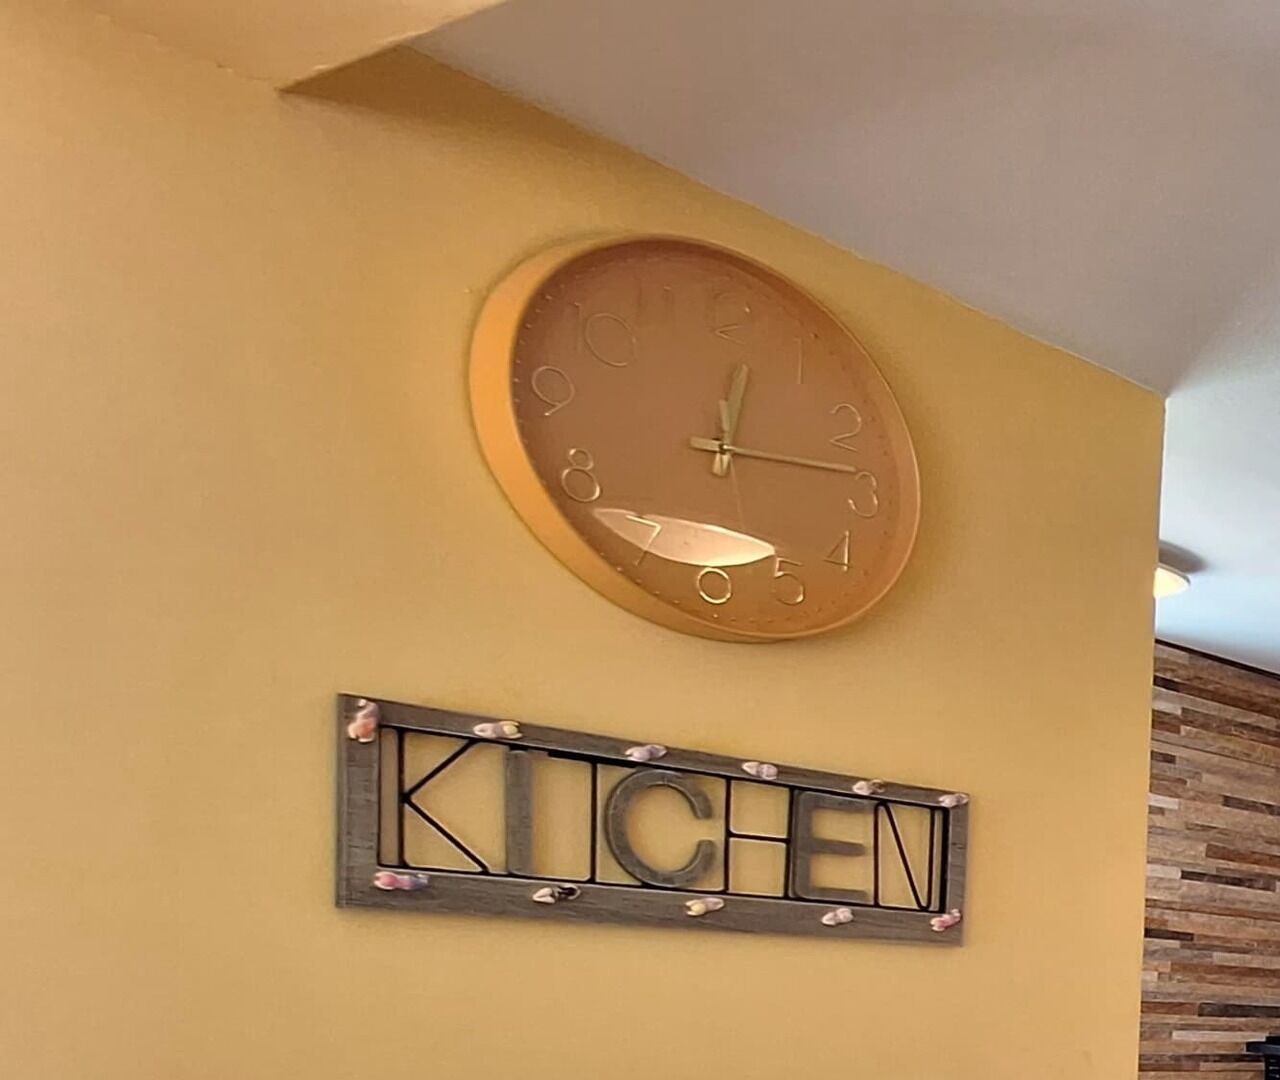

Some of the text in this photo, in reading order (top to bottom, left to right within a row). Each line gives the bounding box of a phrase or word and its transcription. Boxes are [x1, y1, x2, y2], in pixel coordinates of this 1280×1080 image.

[531, 365, 575, 416] 9
[829, 403, 863, 452] 2
[561, 448, 601, 502] 8
[848, 471, 878, 518] 3
[625, 514, 662, 567] 7
[823, 530, 853, 572] 4
[773, 556, 806, 606] 5
[377, 725, 951, 914] KITCHEN
